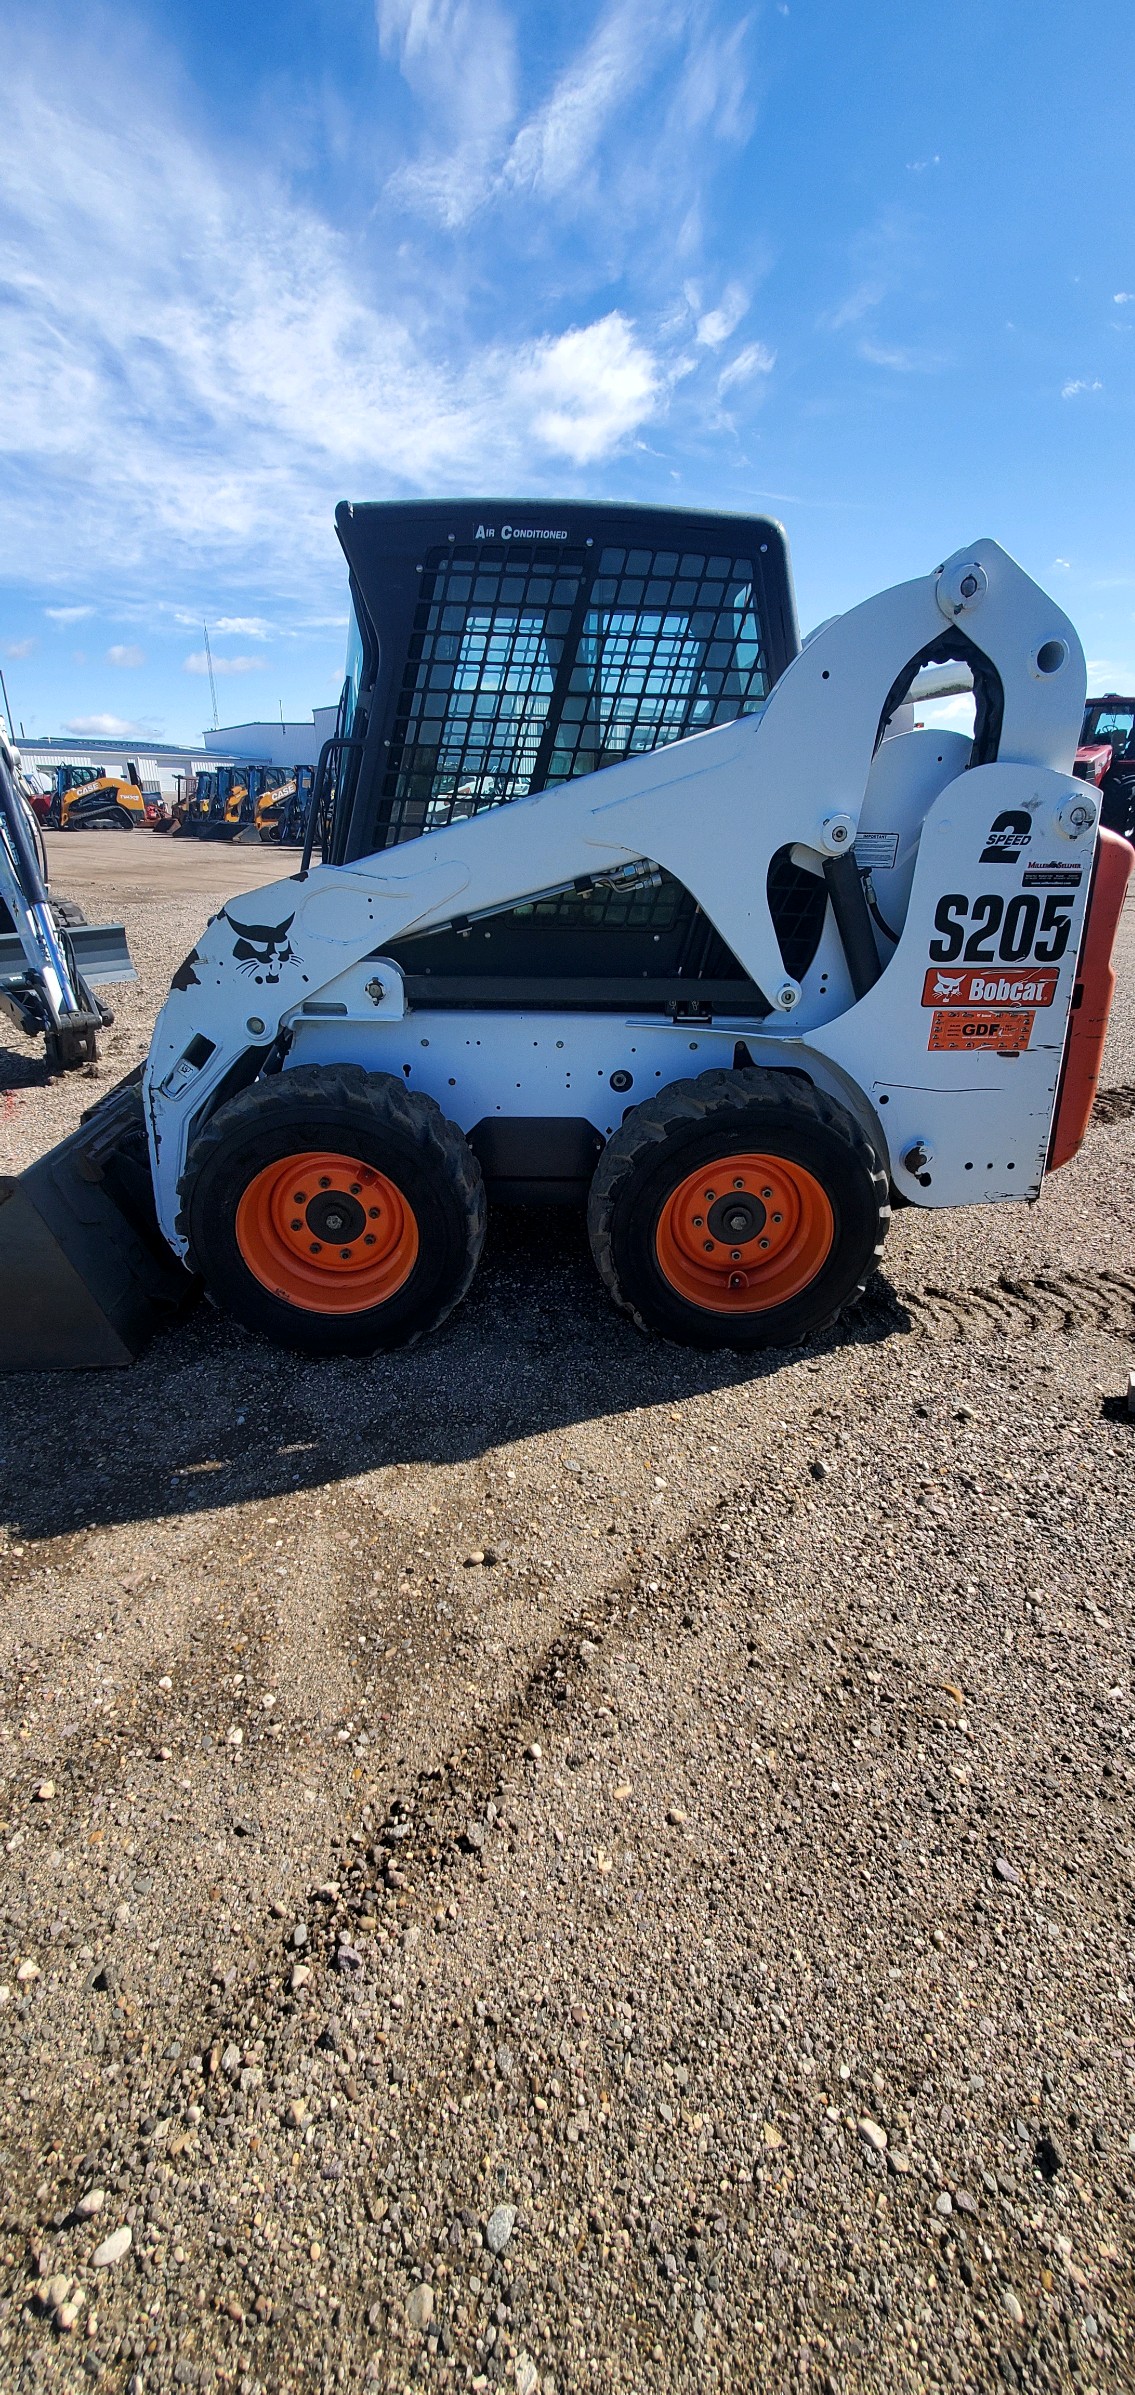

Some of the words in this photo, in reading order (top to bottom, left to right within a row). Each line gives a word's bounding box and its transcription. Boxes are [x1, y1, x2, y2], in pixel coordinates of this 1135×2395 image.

[76, 782, 99, 796] CASE
[271, 784, 295, 801] CASE
[979, 809, 1032, 864] 2
[986, 834, 1032, 846] SPEED
[929, 893, 1075, 963] S205
[968, 978, 1046, 1001] Bobcat
[962, 1023, 1001, 1036] GDF
